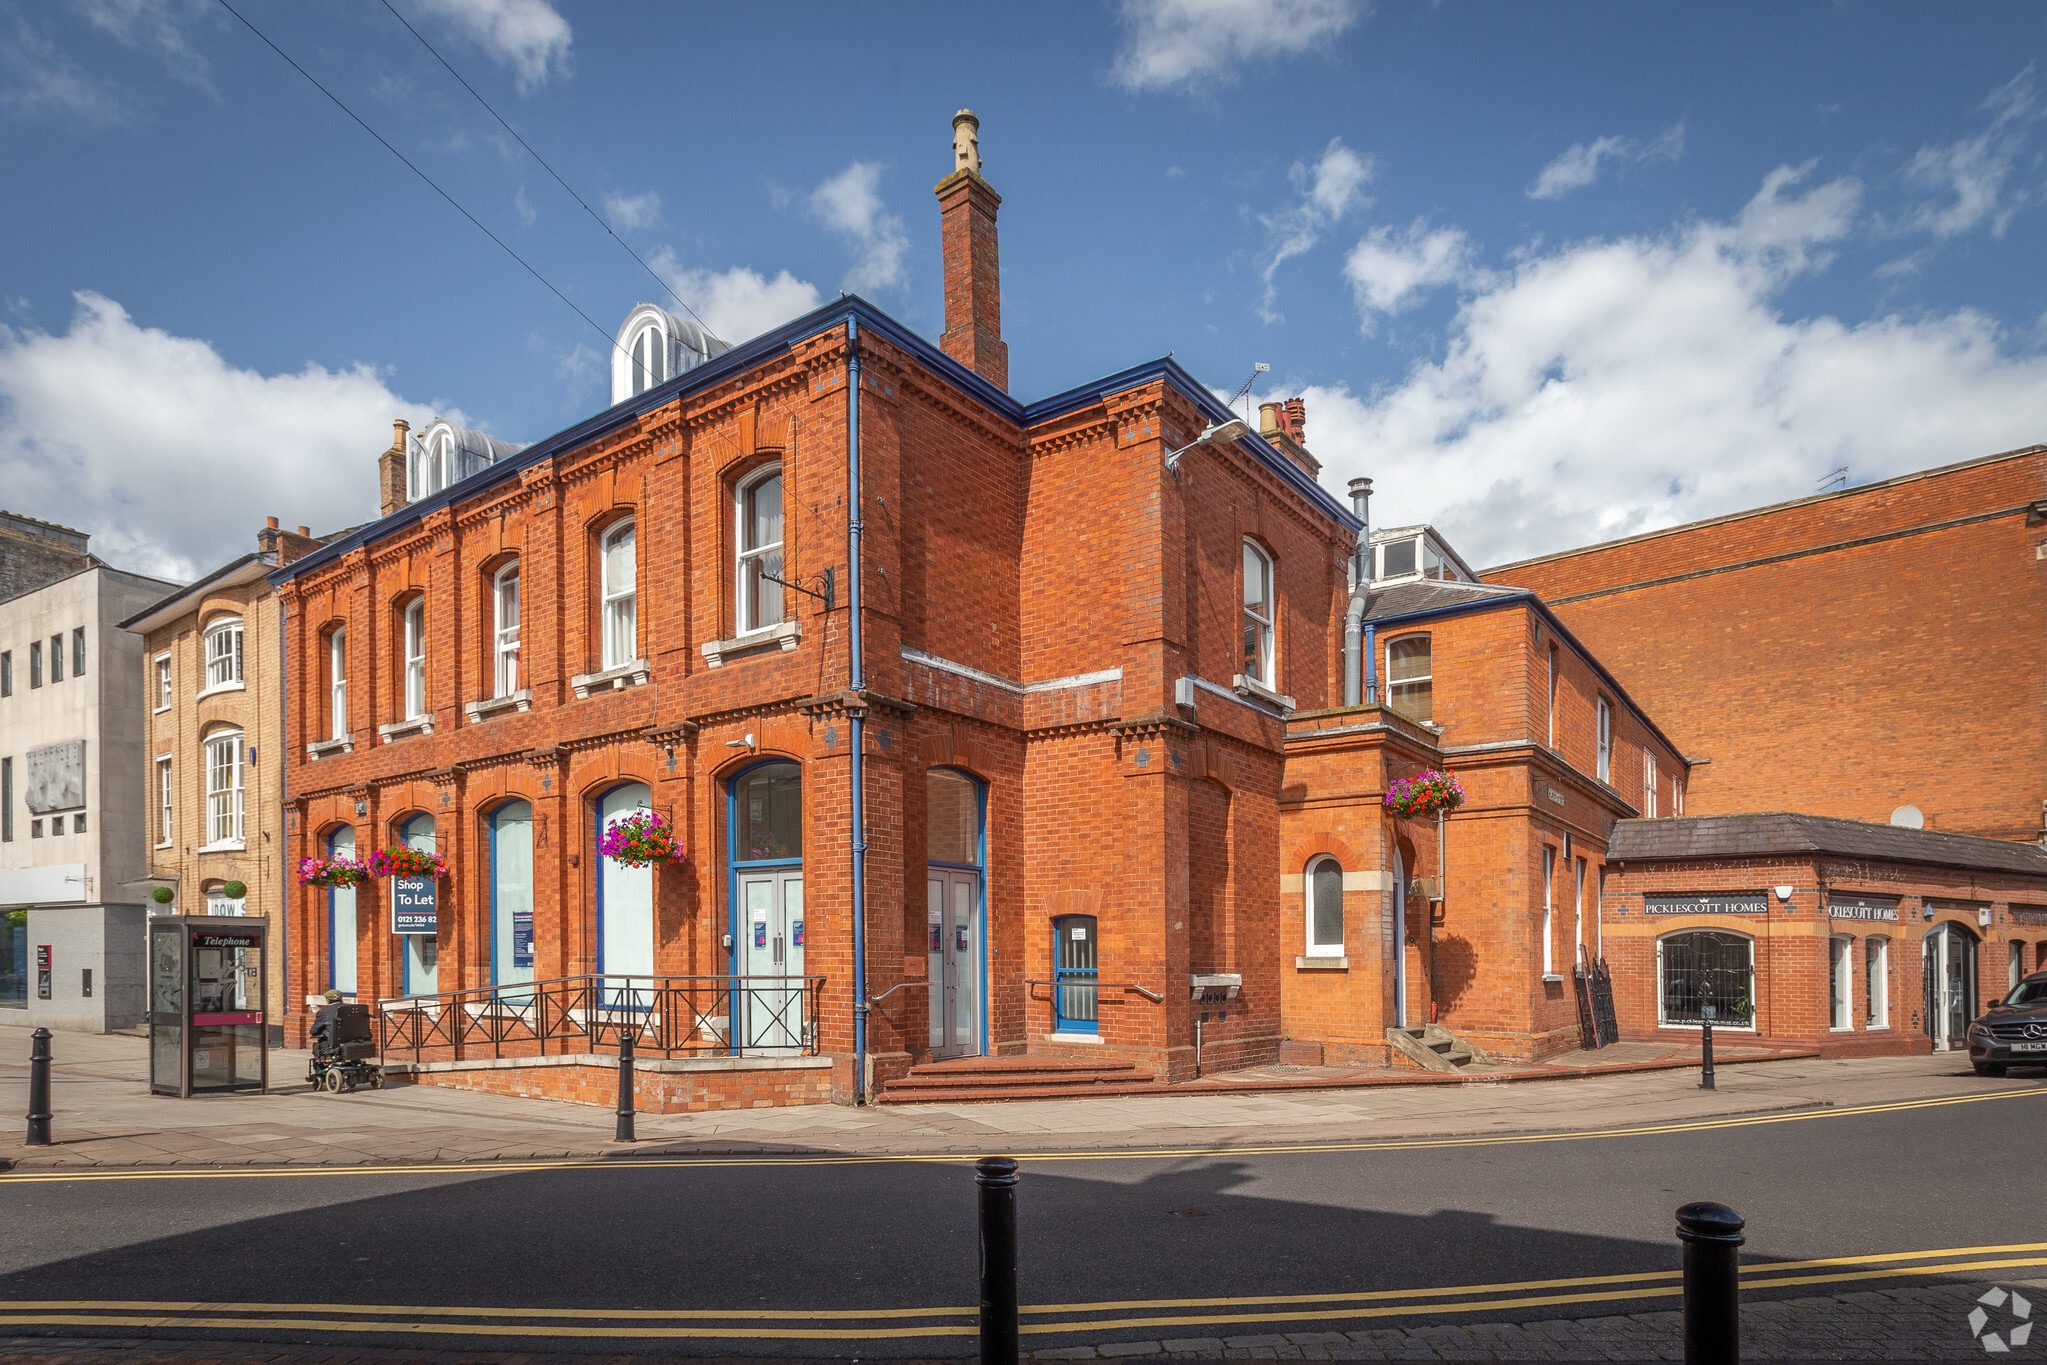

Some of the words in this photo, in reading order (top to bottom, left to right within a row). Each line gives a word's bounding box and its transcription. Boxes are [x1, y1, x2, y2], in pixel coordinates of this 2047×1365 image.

[397, 880, 423, 892] Shop
[397, 894, 412, 905] To
[414, 894, 434, 905] Let
[1645, 903, 1721, 914] PICKLESCOTT
[1725, 902, 1767, 913] HOMES
[397, 915, 413, 923] 0121
[413, 915, 427, 923] 236
[1873, 908, 1898, 921] HOMES
[204, 936, 251, 947] Telephone
